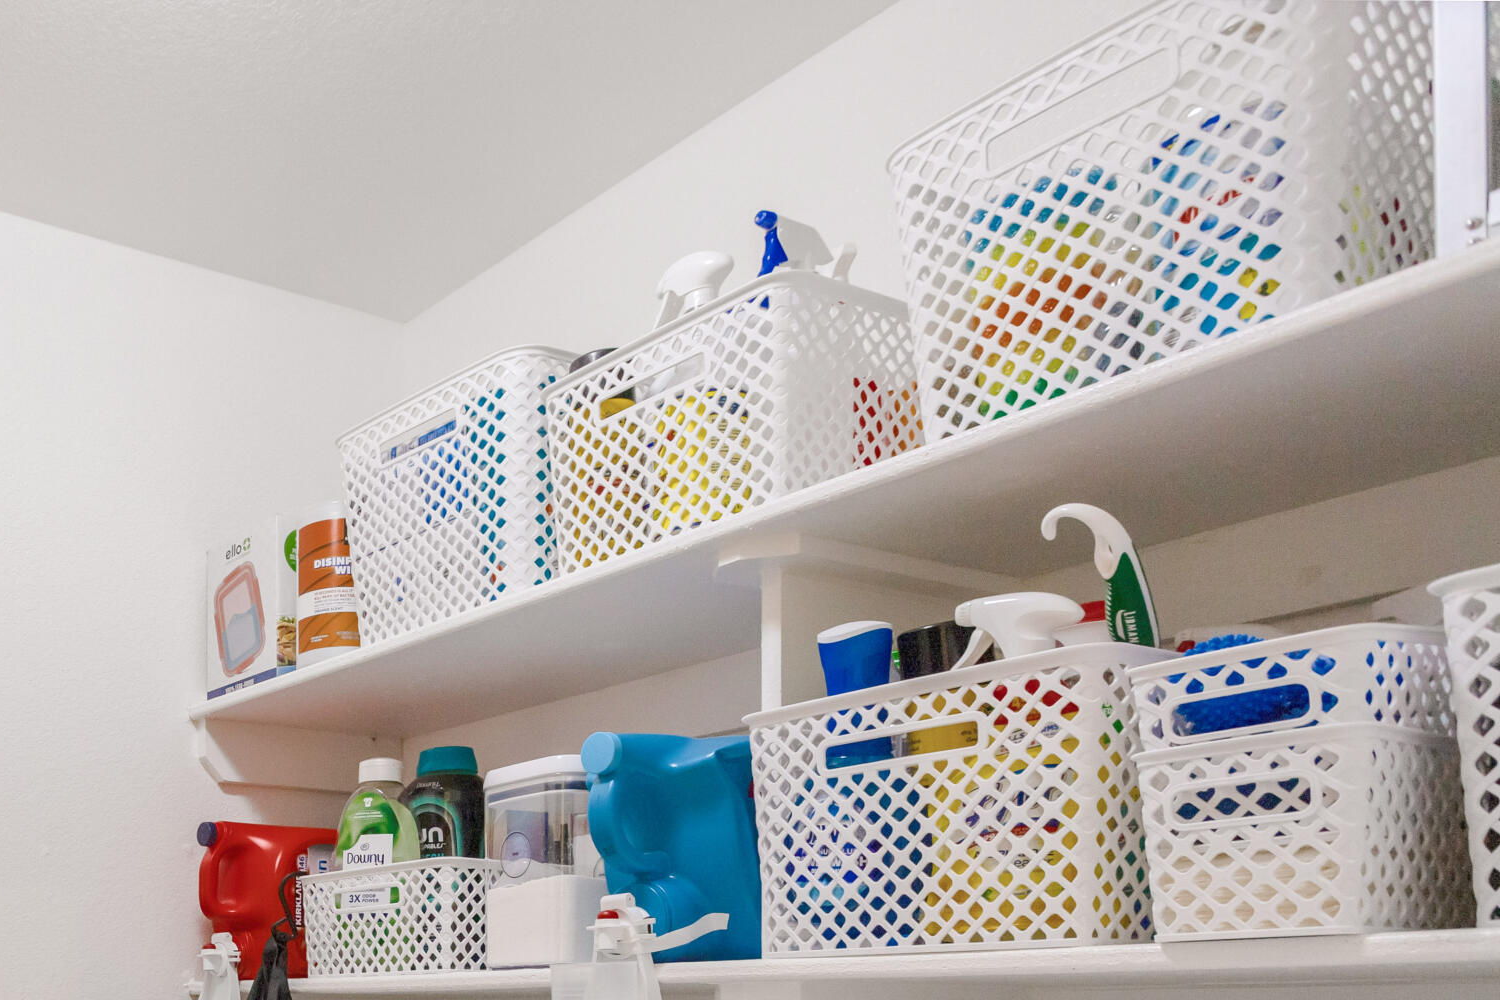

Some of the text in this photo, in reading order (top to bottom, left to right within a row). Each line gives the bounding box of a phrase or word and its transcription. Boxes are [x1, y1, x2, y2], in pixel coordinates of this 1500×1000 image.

[225, 544, 242, 560] ello
[314, 556, 351, 569] DISINF
[346, 852, 385, 866] Downy
[348, 894, 361, 903] 3X
